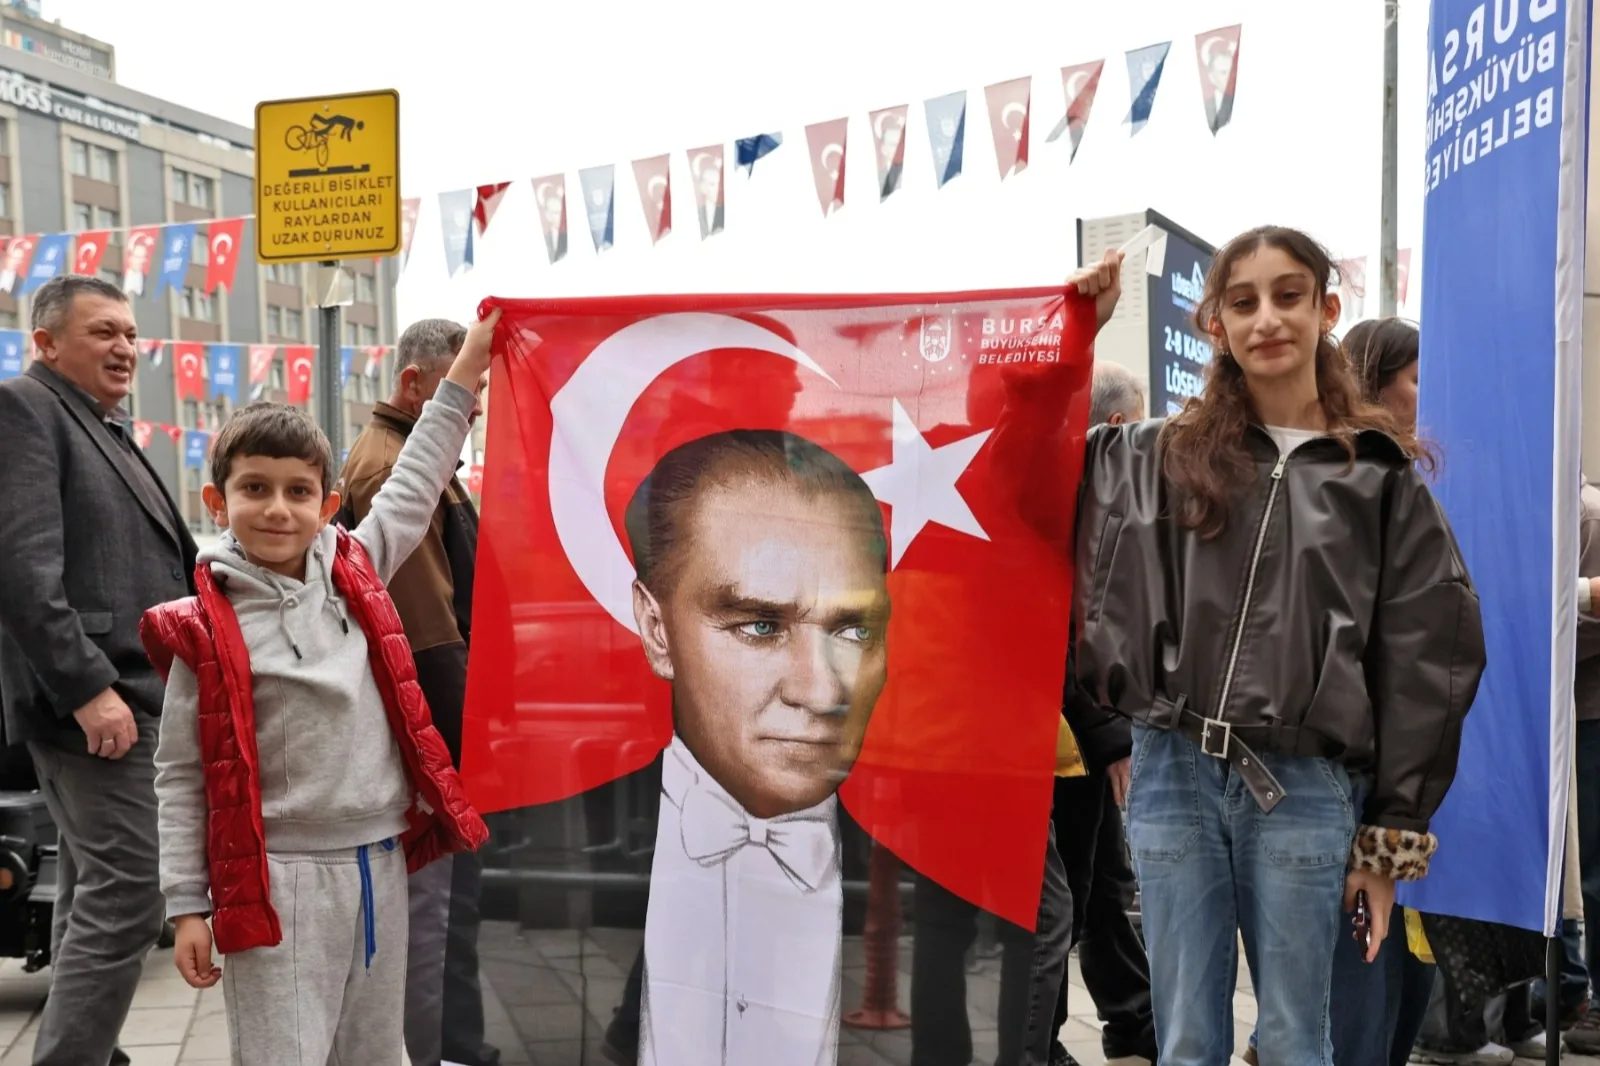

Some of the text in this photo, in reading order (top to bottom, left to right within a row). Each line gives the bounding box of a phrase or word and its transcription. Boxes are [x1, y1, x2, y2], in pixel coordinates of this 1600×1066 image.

[264, 175, 392, 196] DEĞERLİ BİSİKLET
[273, 193, 382, 213] KULLANICILARI
[284, 211, 371, 228] RAYLARDAN
[272, 226, 384, 245] UZAK DURUNUZ
[982, 312, 1064, 335] BURSA
[980, 330, 1062, 350] BÜYÜKŞEHİR
[979, 347, 1061, 365] BELEDİYESİ
